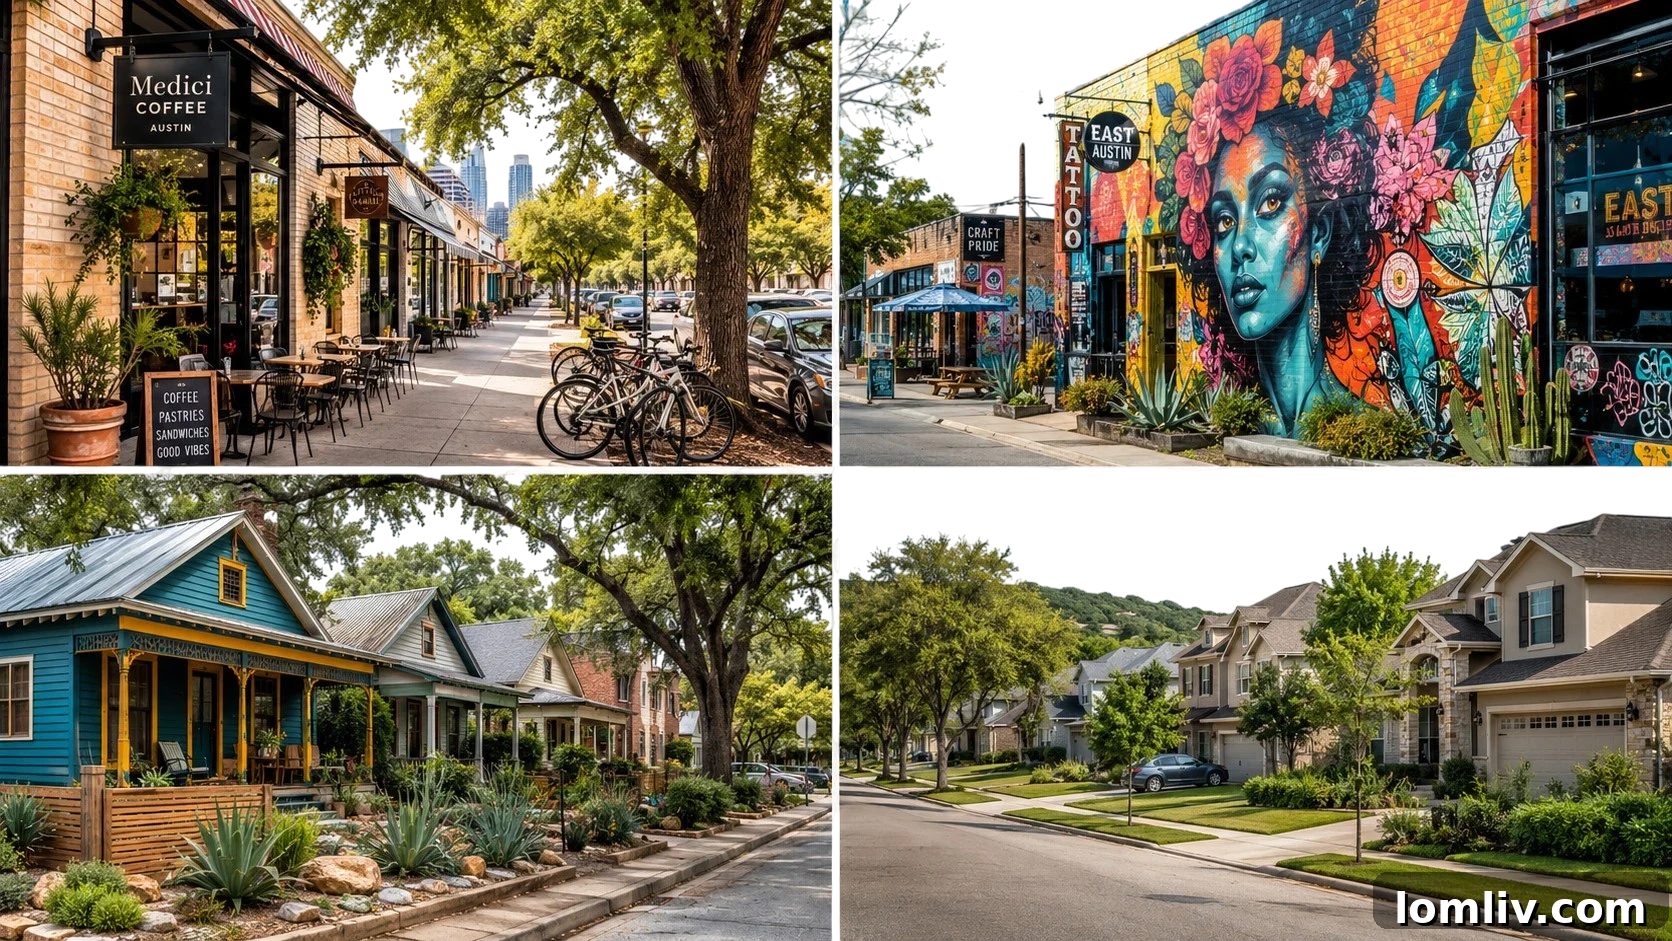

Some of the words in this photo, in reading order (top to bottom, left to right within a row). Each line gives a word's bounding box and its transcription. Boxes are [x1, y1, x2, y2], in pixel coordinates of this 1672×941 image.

[130, 74, 212, 96] Medici
[136, 101, 207, 115] COFFEE
[150, 123, 192, 132] AUSTIN
[1091, 124, 1136, 143] EAST
[1091, 144, 1132, 160] AUSTIN
[1064, 125, 1082, 249] TATTOO
[1605, 184, 1672, 223] EAST
[967, 227, 1000, 239] CRAFT
[968, 240, 999, 252] PRIDE
[163, 391, 199, 404] COFFEE
[159, 409, 205, 423] PASTRIES
[156, 427, 210, 441] SANDWICHES
[157, 446, 181, 458] GOOD
[184, 444, 210, 456] VIBES
